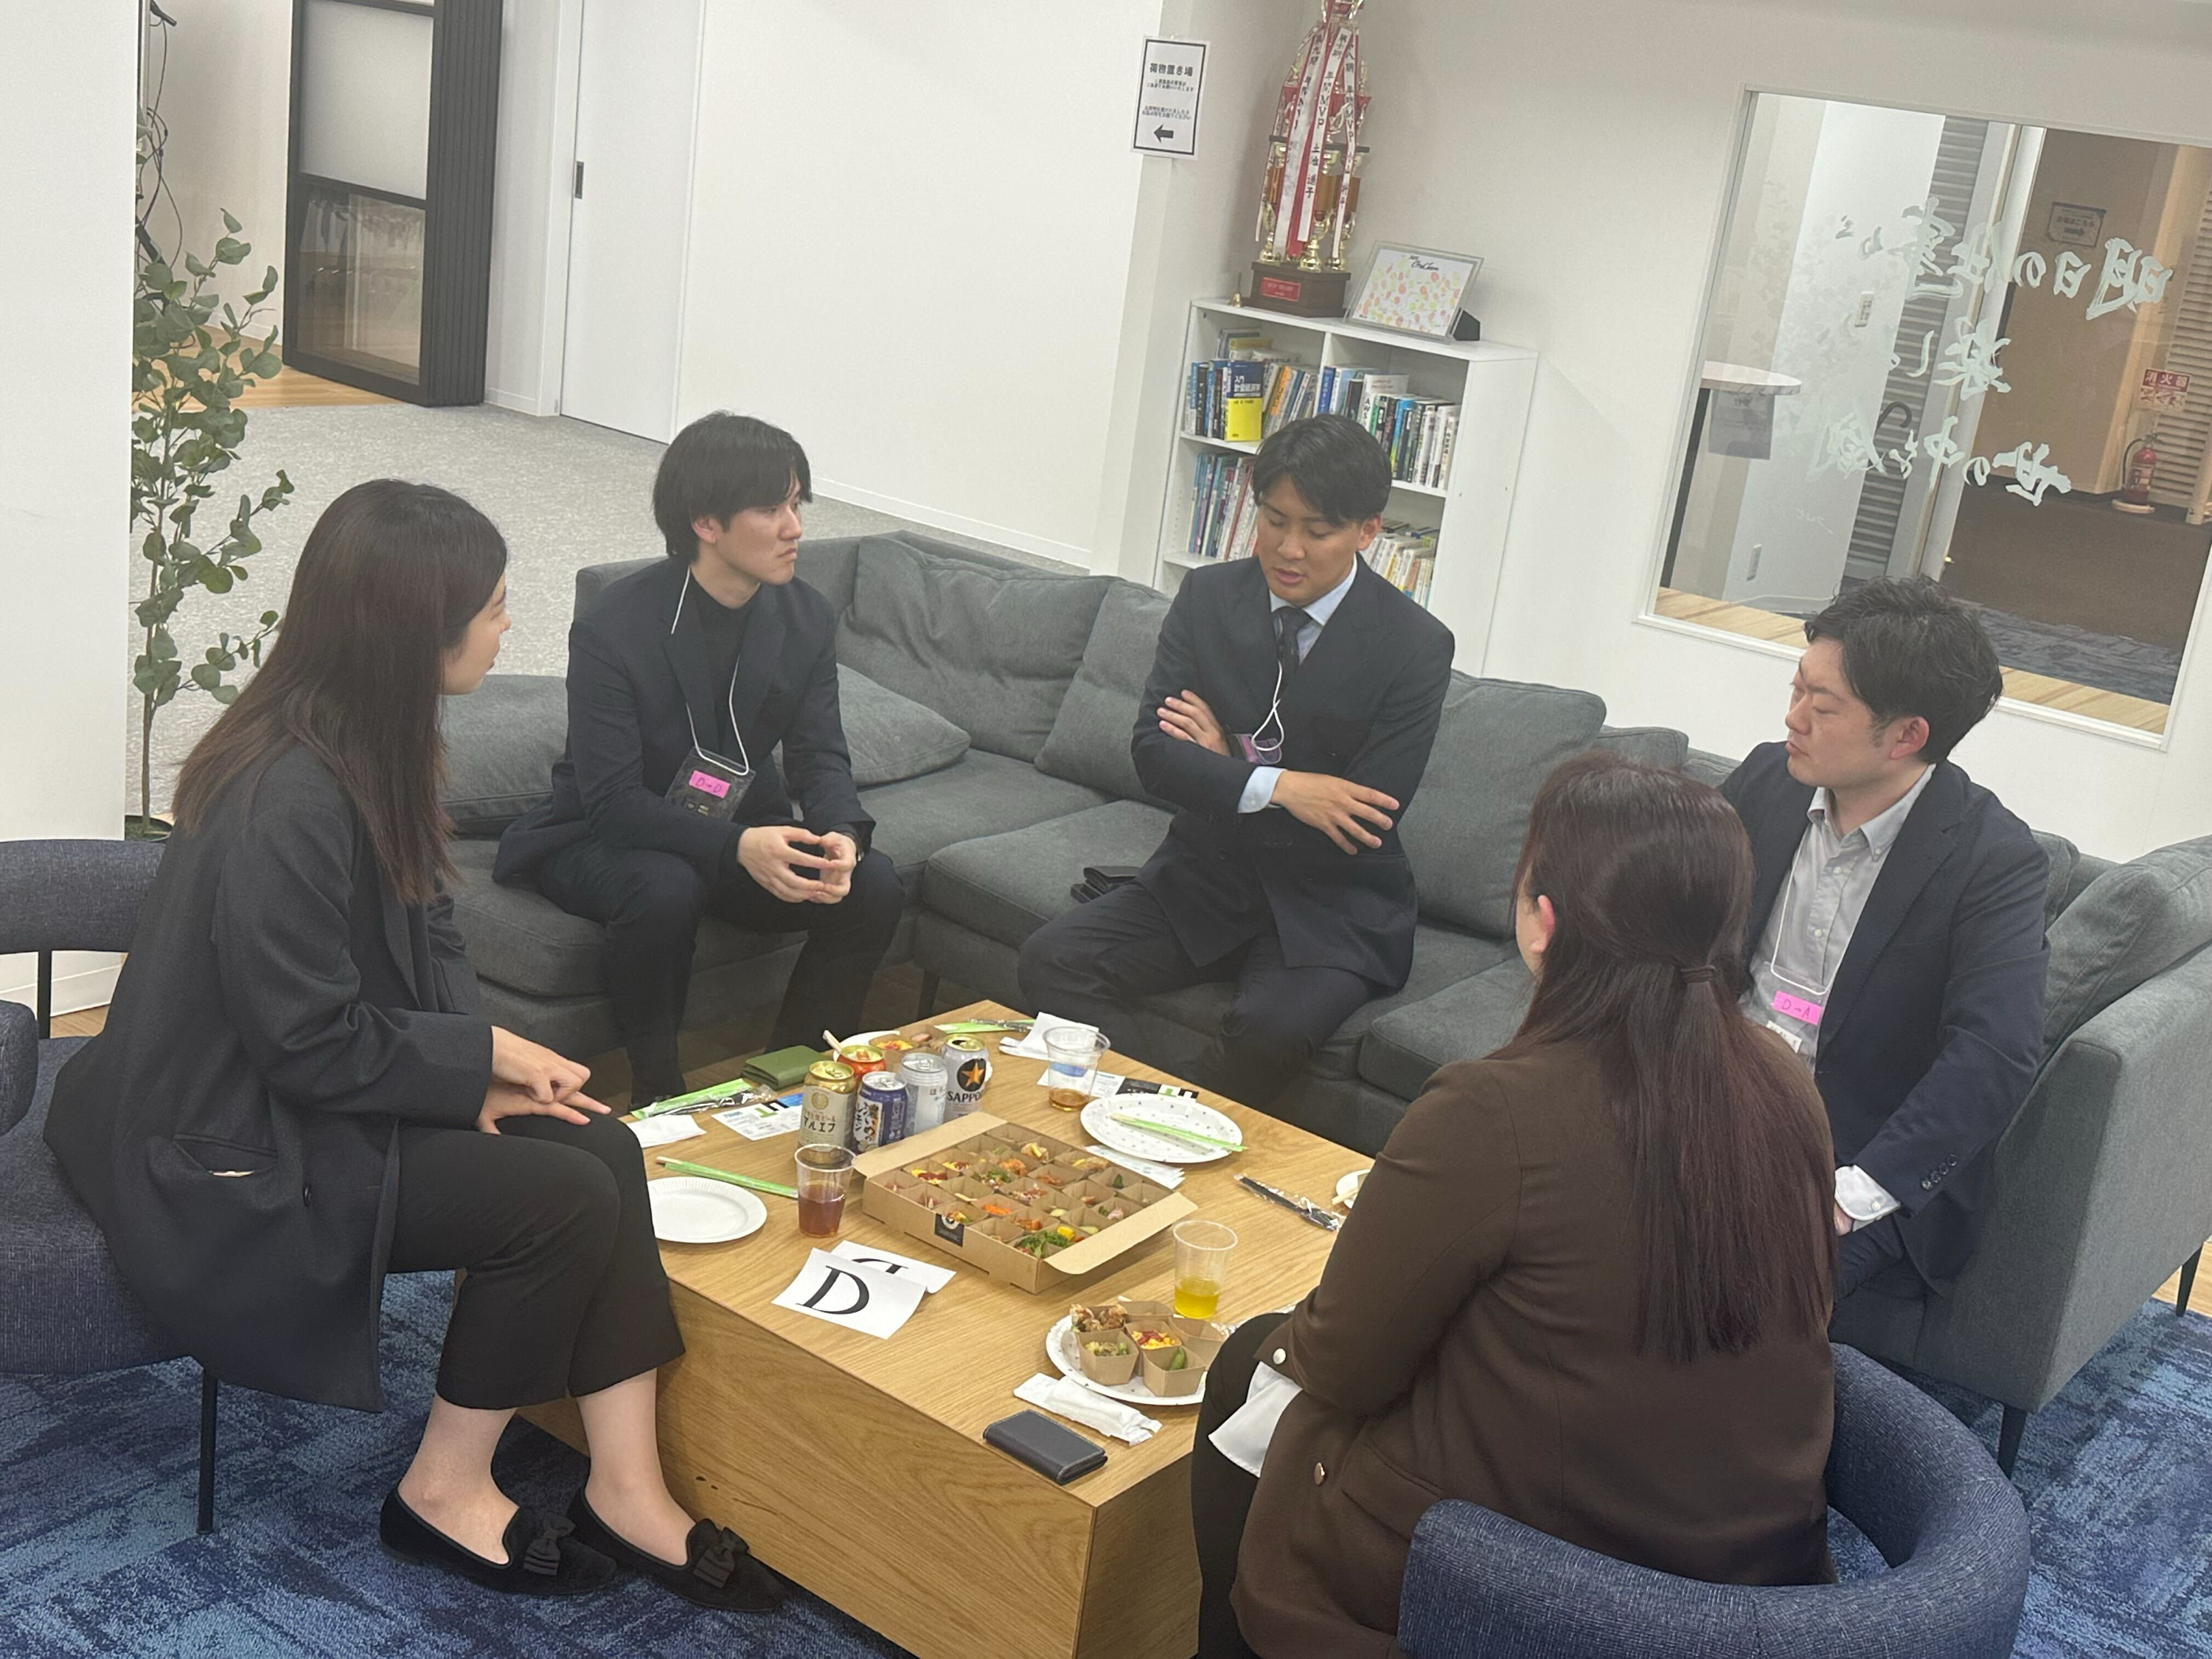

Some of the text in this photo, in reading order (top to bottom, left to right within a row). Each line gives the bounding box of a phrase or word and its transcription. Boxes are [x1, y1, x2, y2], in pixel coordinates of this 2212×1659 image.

[1150, 63, 1193, 77] 荷物置き場
[2145, 370, 2188, 388] 消火器
[804, 1115, 835, 1133] マルエフ
[796, 1265, 869, 1315] D
